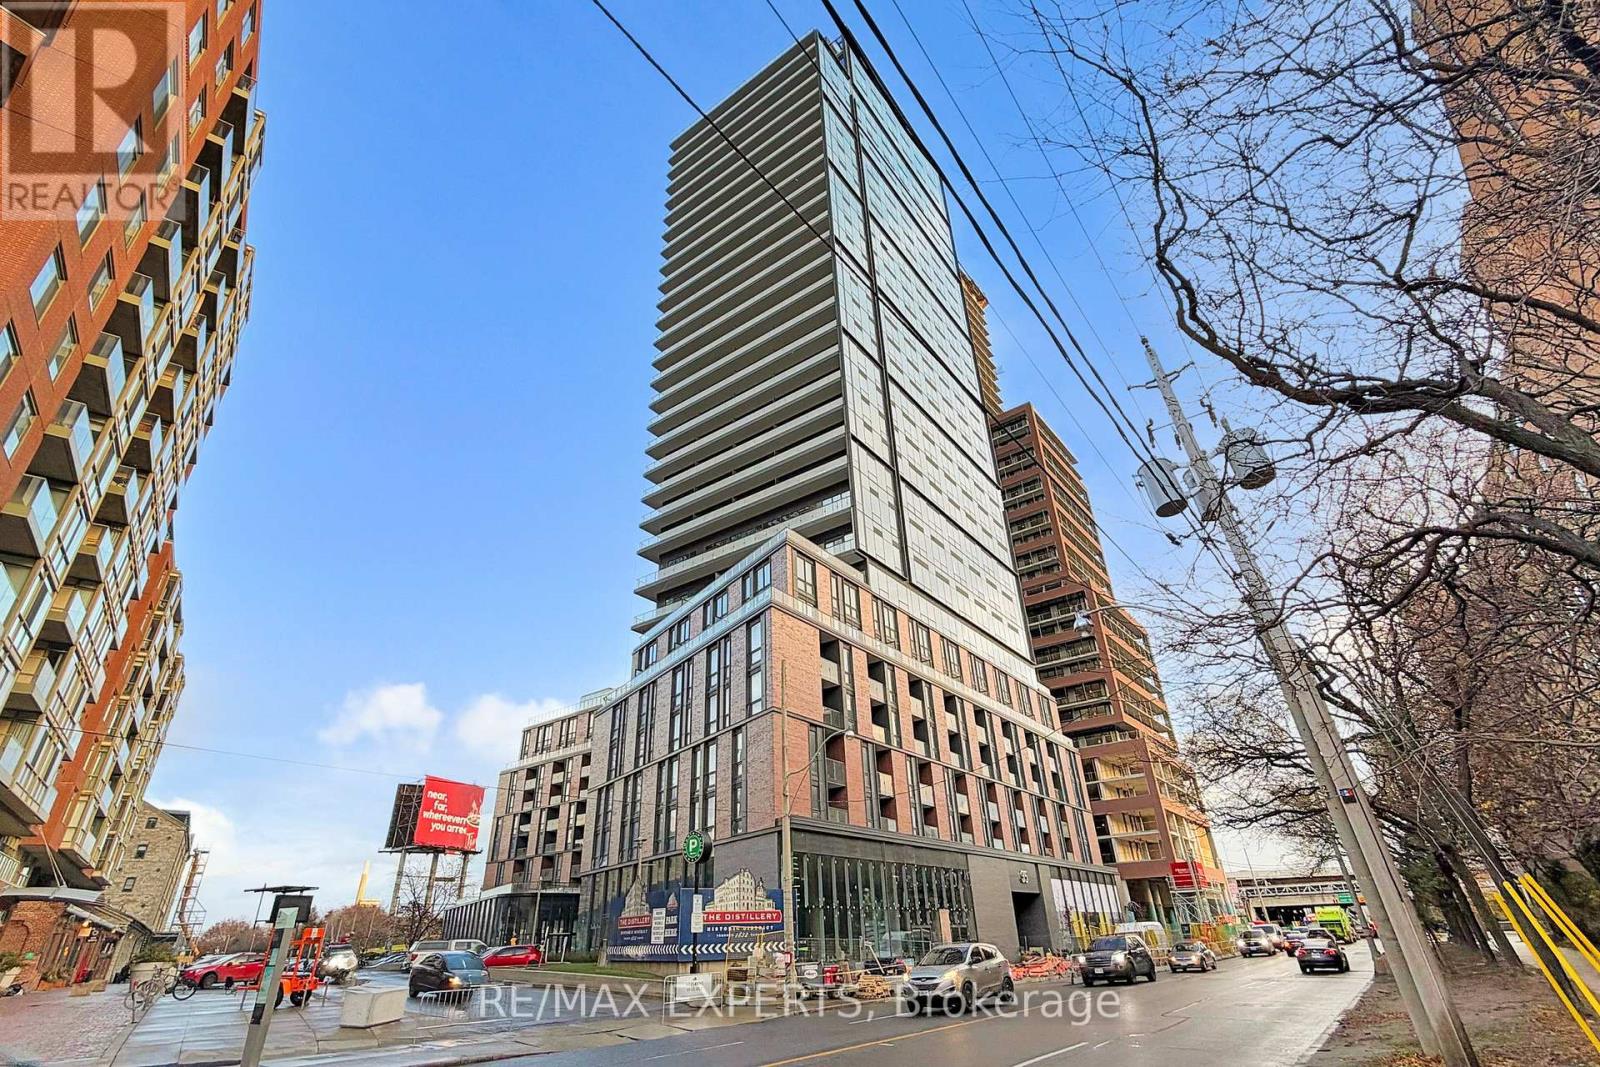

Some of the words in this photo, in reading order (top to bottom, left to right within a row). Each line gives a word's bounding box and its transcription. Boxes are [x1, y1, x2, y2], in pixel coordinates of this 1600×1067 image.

[427, 790, 447, 803] near,
[434, 800, 448, 813] far,
[430, 822, 446, 832] you
[689, 838, 698, 852] P
[703, 912, 721, 921] THE
[725, 911, 778, 921] DISTILLERY
